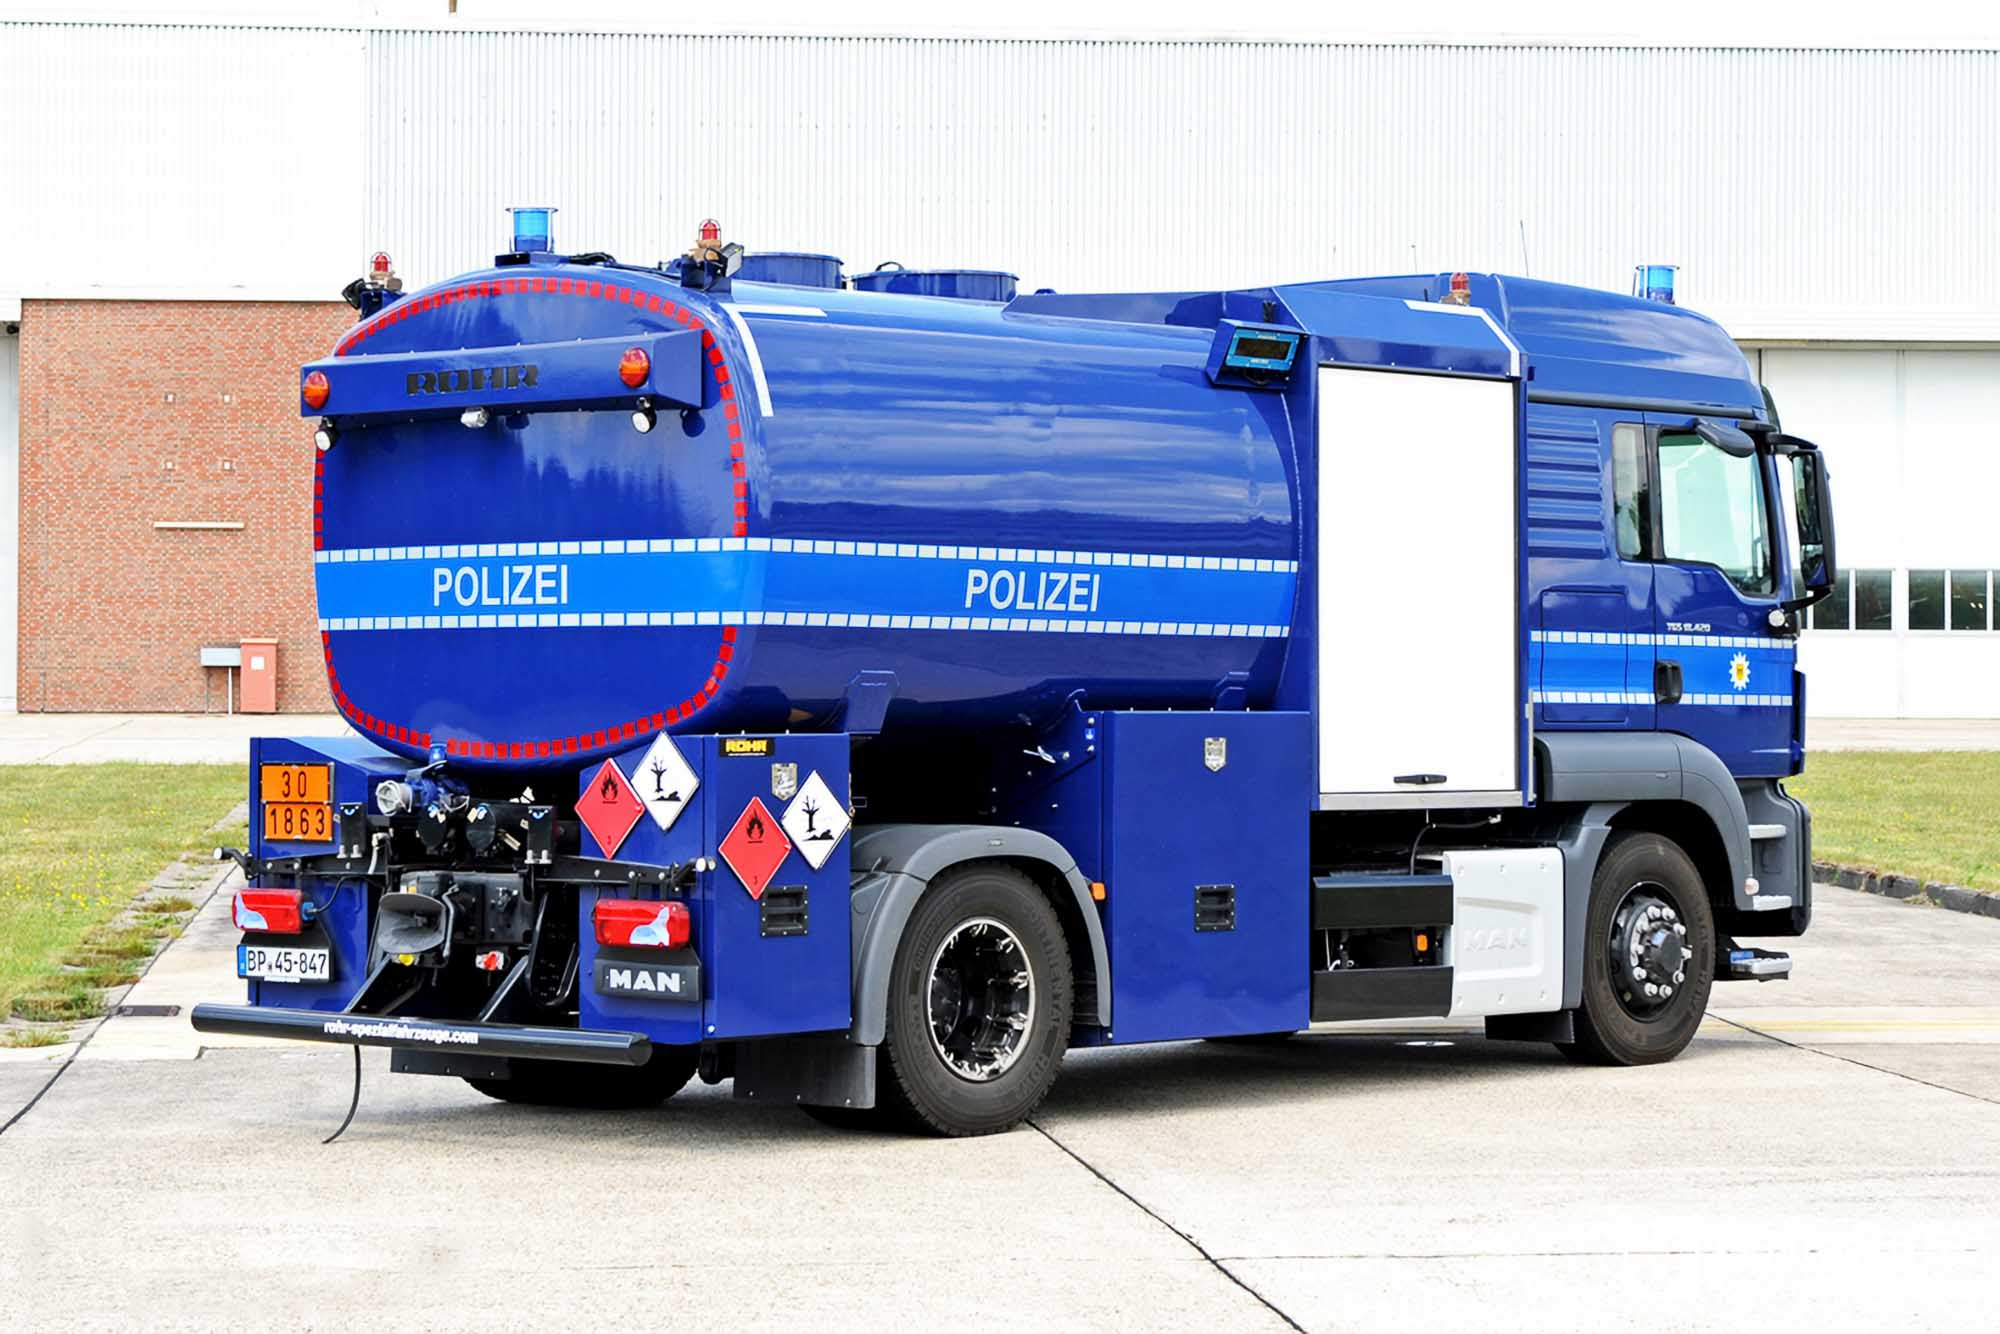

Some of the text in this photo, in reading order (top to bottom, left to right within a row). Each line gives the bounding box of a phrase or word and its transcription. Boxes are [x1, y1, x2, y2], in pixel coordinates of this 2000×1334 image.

[406, 364, 538, 396] ROHR
[433, 564, 568, 607] POLIZEI
[964, 568, 1101, 612] POLIZEI
[282, 770, 307, 798] 30
[270, 807, 325, 835] 1863
[609, 968, 681, 993] MAN
